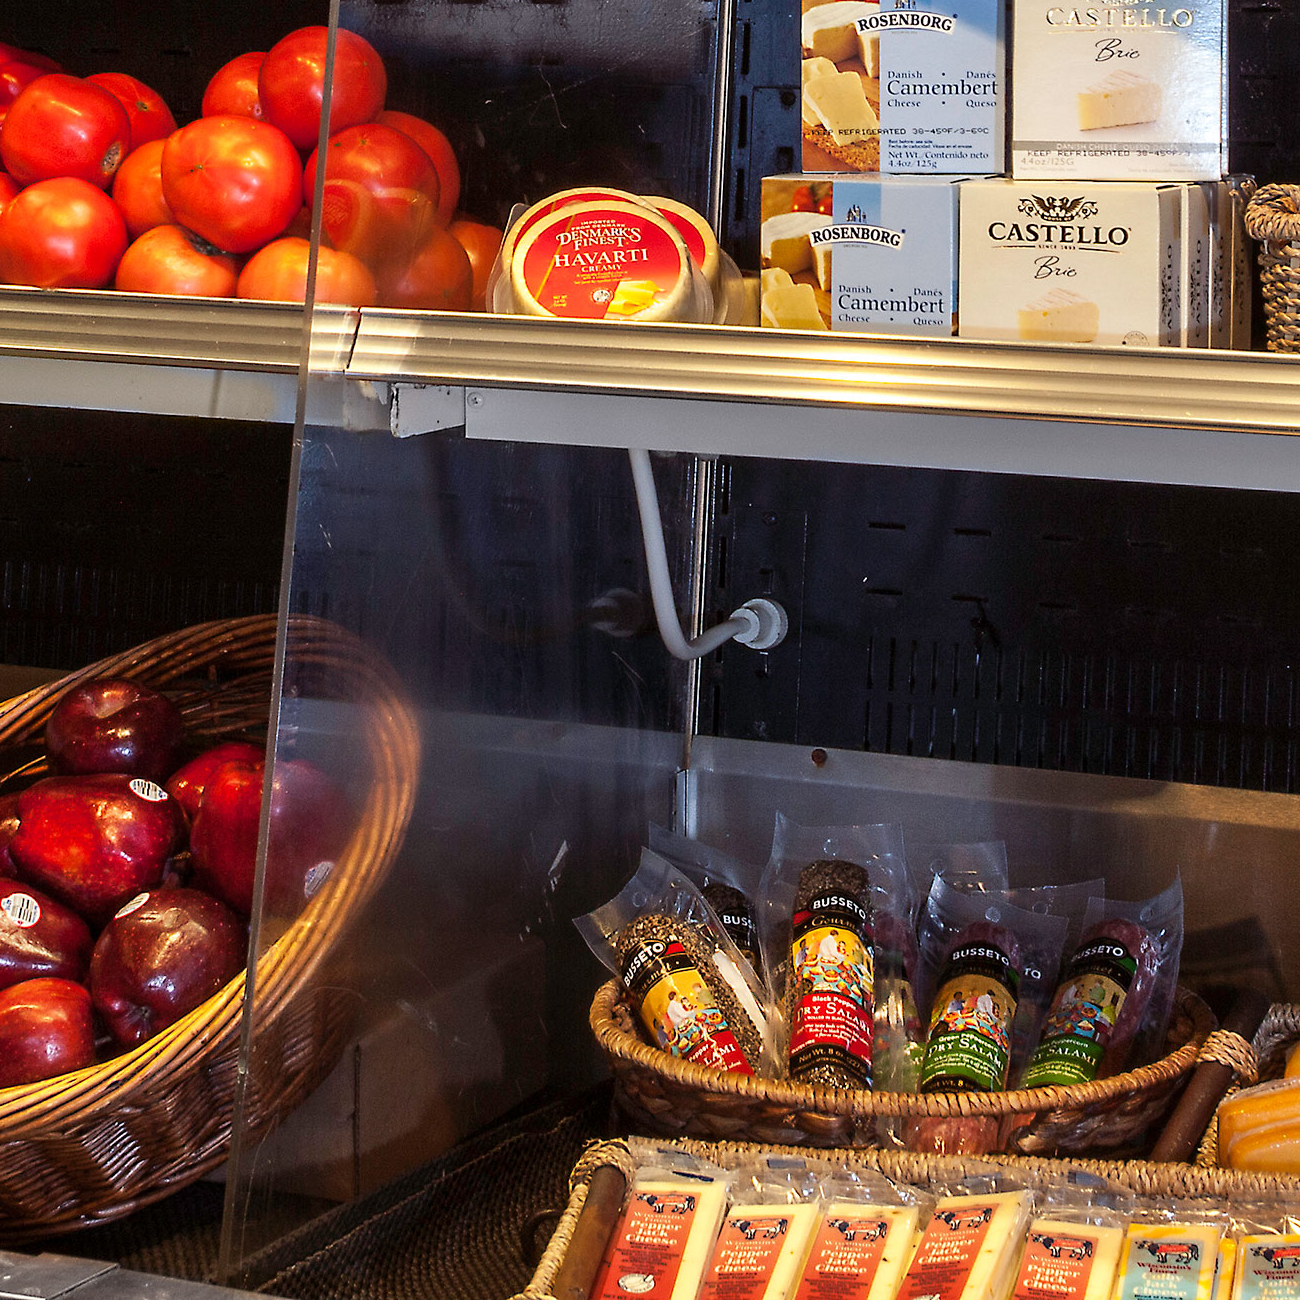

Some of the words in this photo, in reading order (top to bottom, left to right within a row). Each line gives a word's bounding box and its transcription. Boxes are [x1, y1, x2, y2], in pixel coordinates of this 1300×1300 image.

[857, 13, 954, 33] ROSENBORG
[1045, 7, 1194, 28] CASTELLO
[1095, 37, 1140, 63] Brie
[887, 70, 922, 80] Danish
[966, 69, 996, 80] Danés
[887, 78, 998, 97] Camembert
[887, 99, 921, 108] Cheese
[966, 99, 997, 110] Queso
[888, 151, 902, 159] Net
[970, 151, 989, 159] neto
[556, 228, 641, 245] DENMARK'S
[810, 227, 902, 248] ROSENBORG
[987, 221, 1129, 246] CASTELLO
[574, 237, 625, 251] FINEST
[554, 249, 649, 267] HAVARTI
[581, 264, 621, 272] CREAMY
[1034, 255, 1078, 279] Brie
[838, 285, 872, 294] Danish
[913, 286, 943, 298] Danés
[838, 294, 945, 314] Camembert
[838, 314, 871, 324] Cheese
[913, 316, 943, 327] Queso
[812, 896, 866, 920] BUSSETO
[953, 948, 1010, 966] BUSSETO
[623, 942, 664, 987] BUSSETO
[812, 995, 832, 1003] Black
[928, 1041, 957, 1057] DRY
[1048, 1048, 1096, 1066] SALAMI
[630, 1220, 682, 1231] Pepper
[635, 1229, 668, 1238] Jack
[625, 1234, 678, 1245] Cheese
[924, 1239, 976, 1250] Pepper
[720, 1250, 772, 1259] Pepper
[820, 1250, 872, 1260] Pepper
[930, 1246, 961, 1256] Jack
[725, 1257, 758, 1265] Jack
[825, 1257, 859, 1267] Jack
[917, 1253, 969, 1265] Cheese
[714, 1264, 766, 1272] Cheese
[815, 1264, 868, 1274] Cheese
[1026, 1264, 1081, 1278] Pepper
[1033, 1275, 1067, 1285] Jack
[1142, 1273, 1181, 1283] Colby
[1259, 1279, 1299, 1288] Colby
[1022, 1279, 1077, 1293] Cheese
[1143, 1280, 1178, 1289] Jack
[1132, 1286, 1188, 1297] Cheese
[1260, 1286, 1295, 1296] Jack
